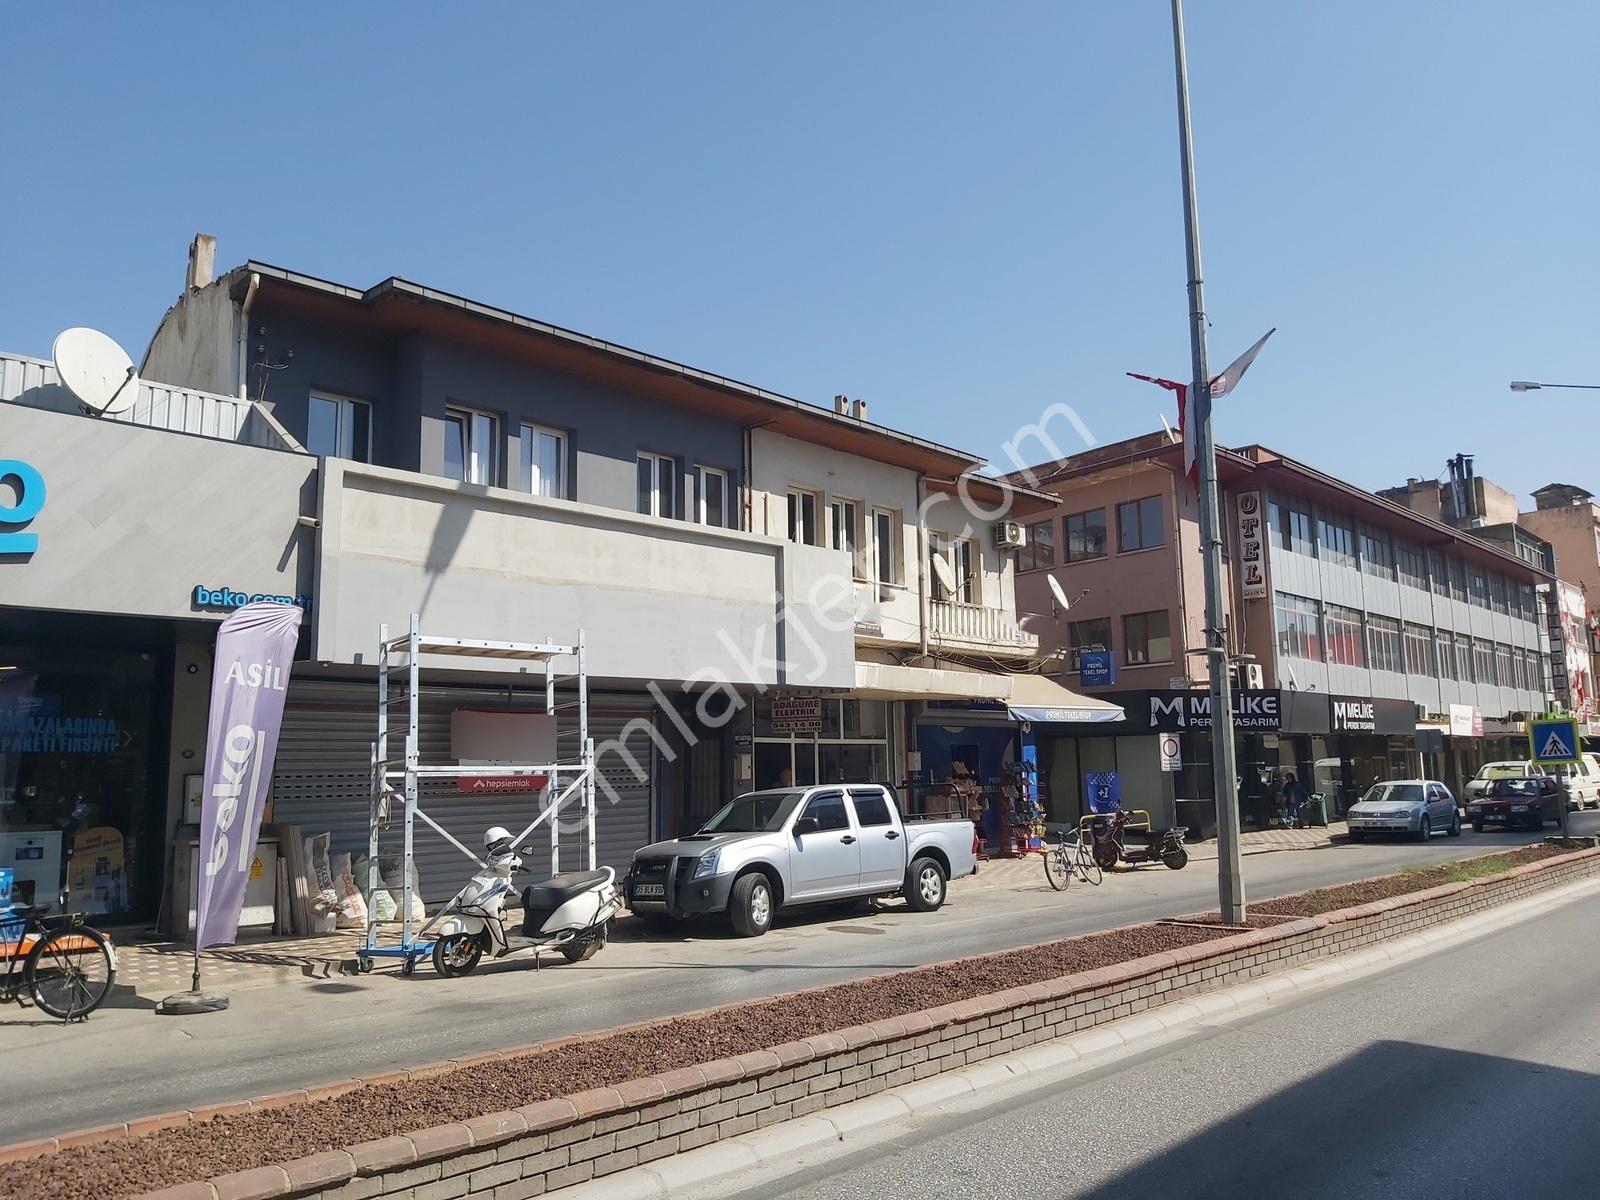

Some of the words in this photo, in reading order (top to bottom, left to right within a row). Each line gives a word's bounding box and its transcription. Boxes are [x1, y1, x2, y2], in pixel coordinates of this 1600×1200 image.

[1240, 495, 1262, 586] OTEL
[197, 586, 312, 609] bekocomtr
[224, 659, 285, 691] ASİL
[1347, 701, 1374, 719] MELİKE
[206, 724, 256, 876] beko
[1097, 787, 1109, 798] +1
